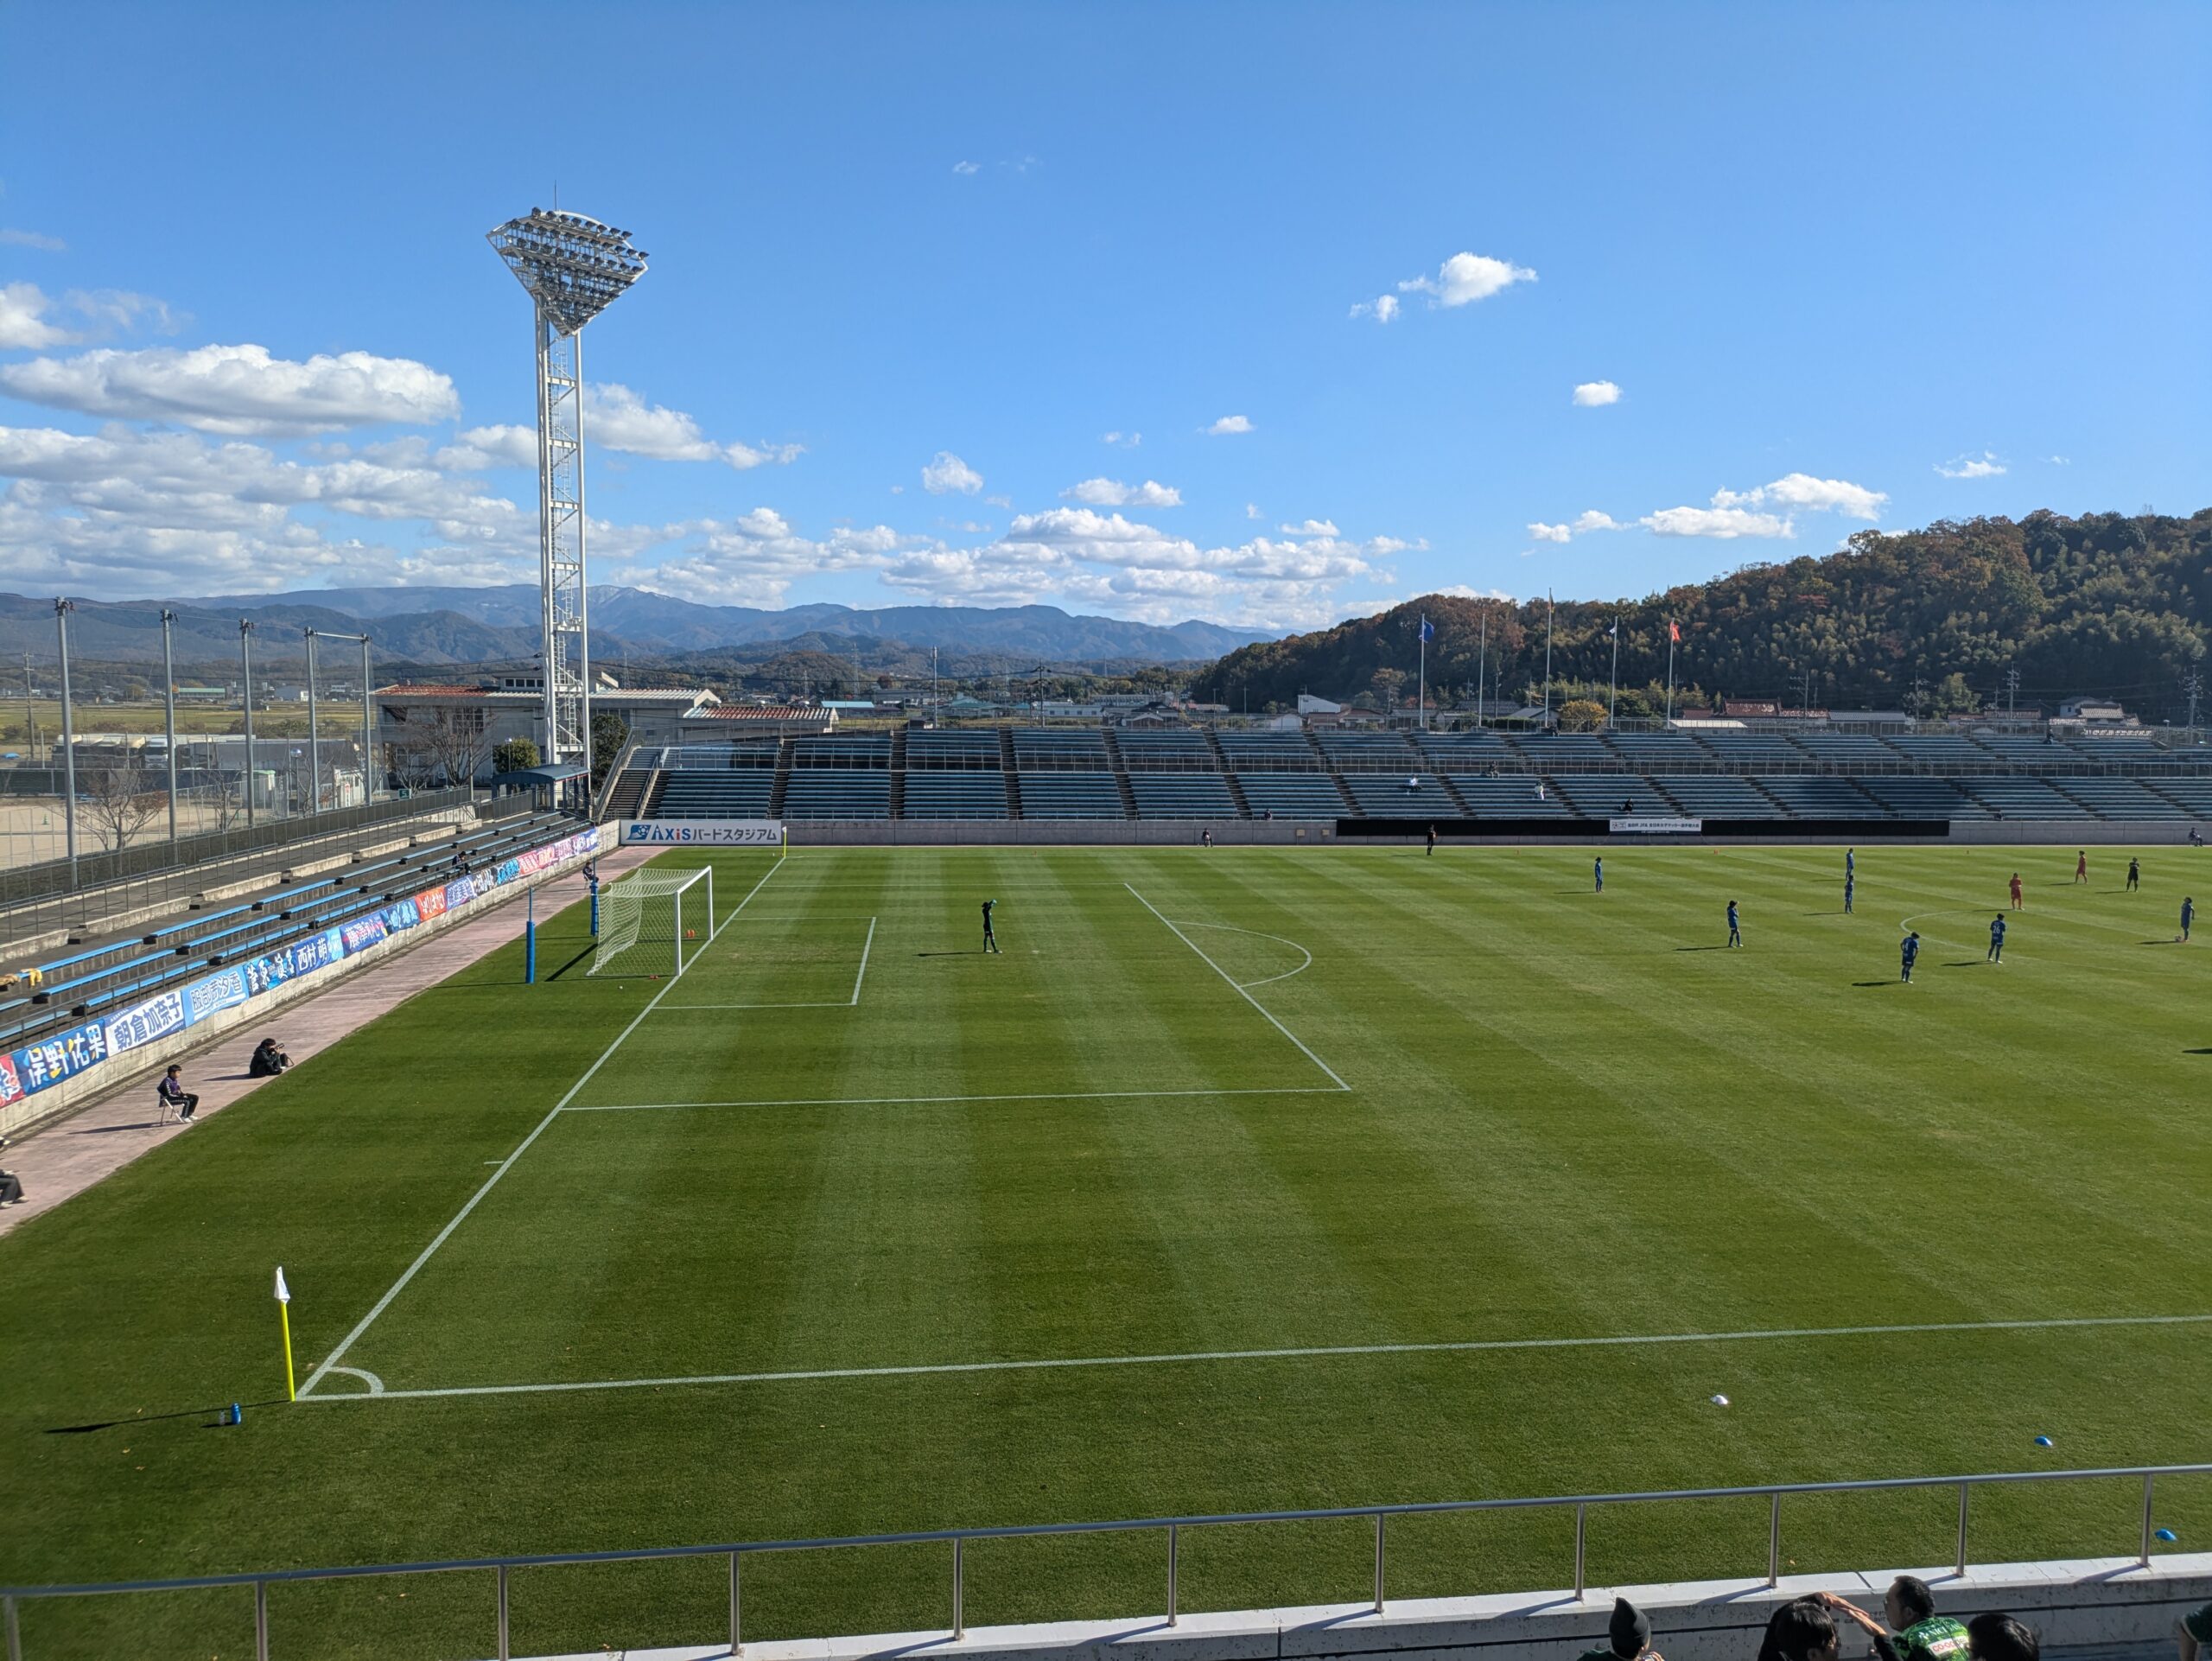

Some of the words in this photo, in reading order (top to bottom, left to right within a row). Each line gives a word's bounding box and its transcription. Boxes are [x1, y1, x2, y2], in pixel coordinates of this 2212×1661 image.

[692, 828, 777, 841] バードスタジアム
[296, 937, 327, 971] 西村萌
[113, 992, 181, 1052] 朝倉加奈子
